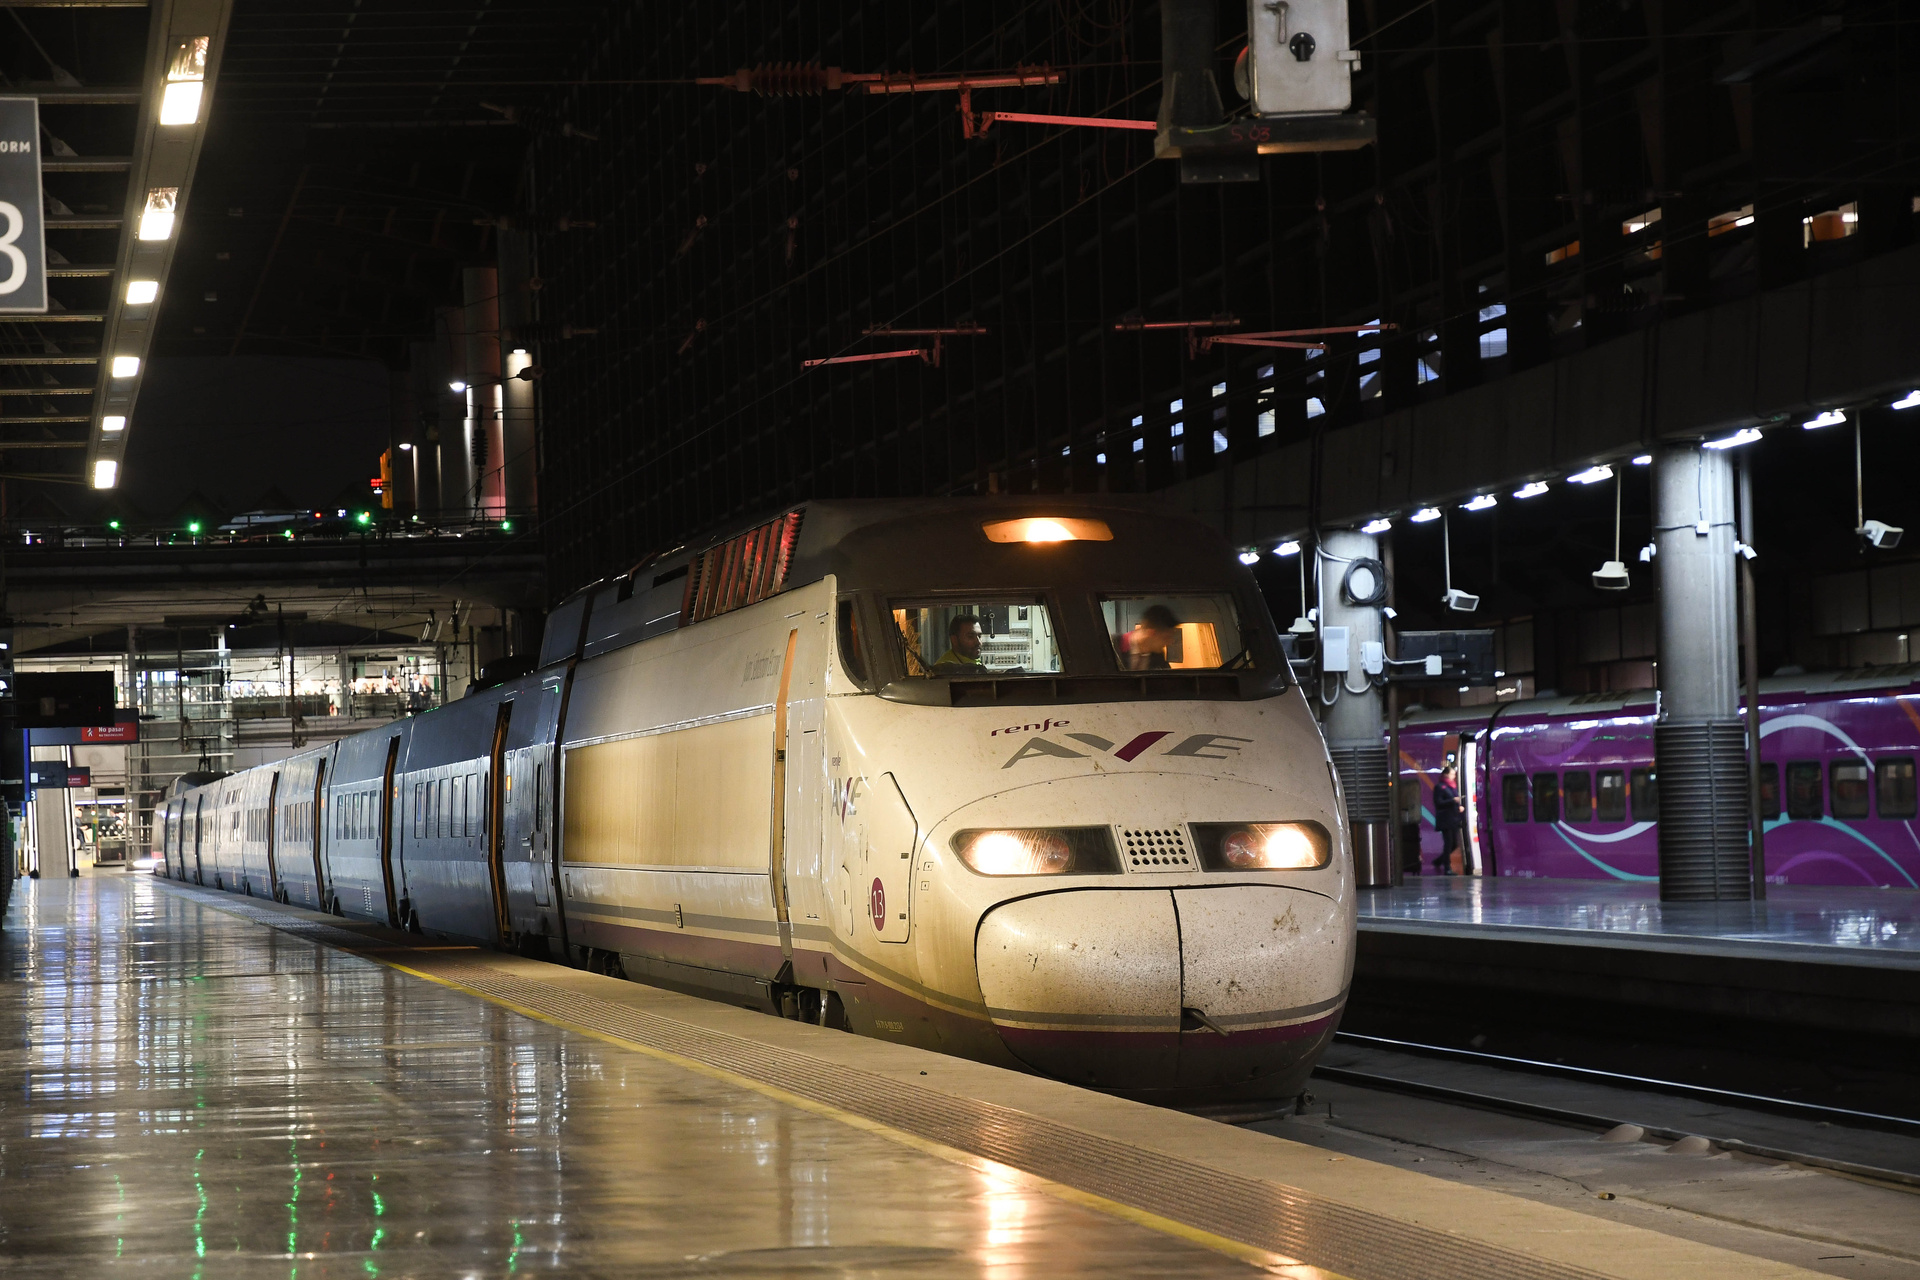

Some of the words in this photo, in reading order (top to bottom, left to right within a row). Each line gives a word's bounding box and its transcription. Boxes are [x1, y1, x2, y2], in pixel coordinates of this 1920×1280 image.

[991, 718, 1070, 736] renfe
[1000, 731, 1254, 769] AVE
[873, 890, 884, 918] 13
